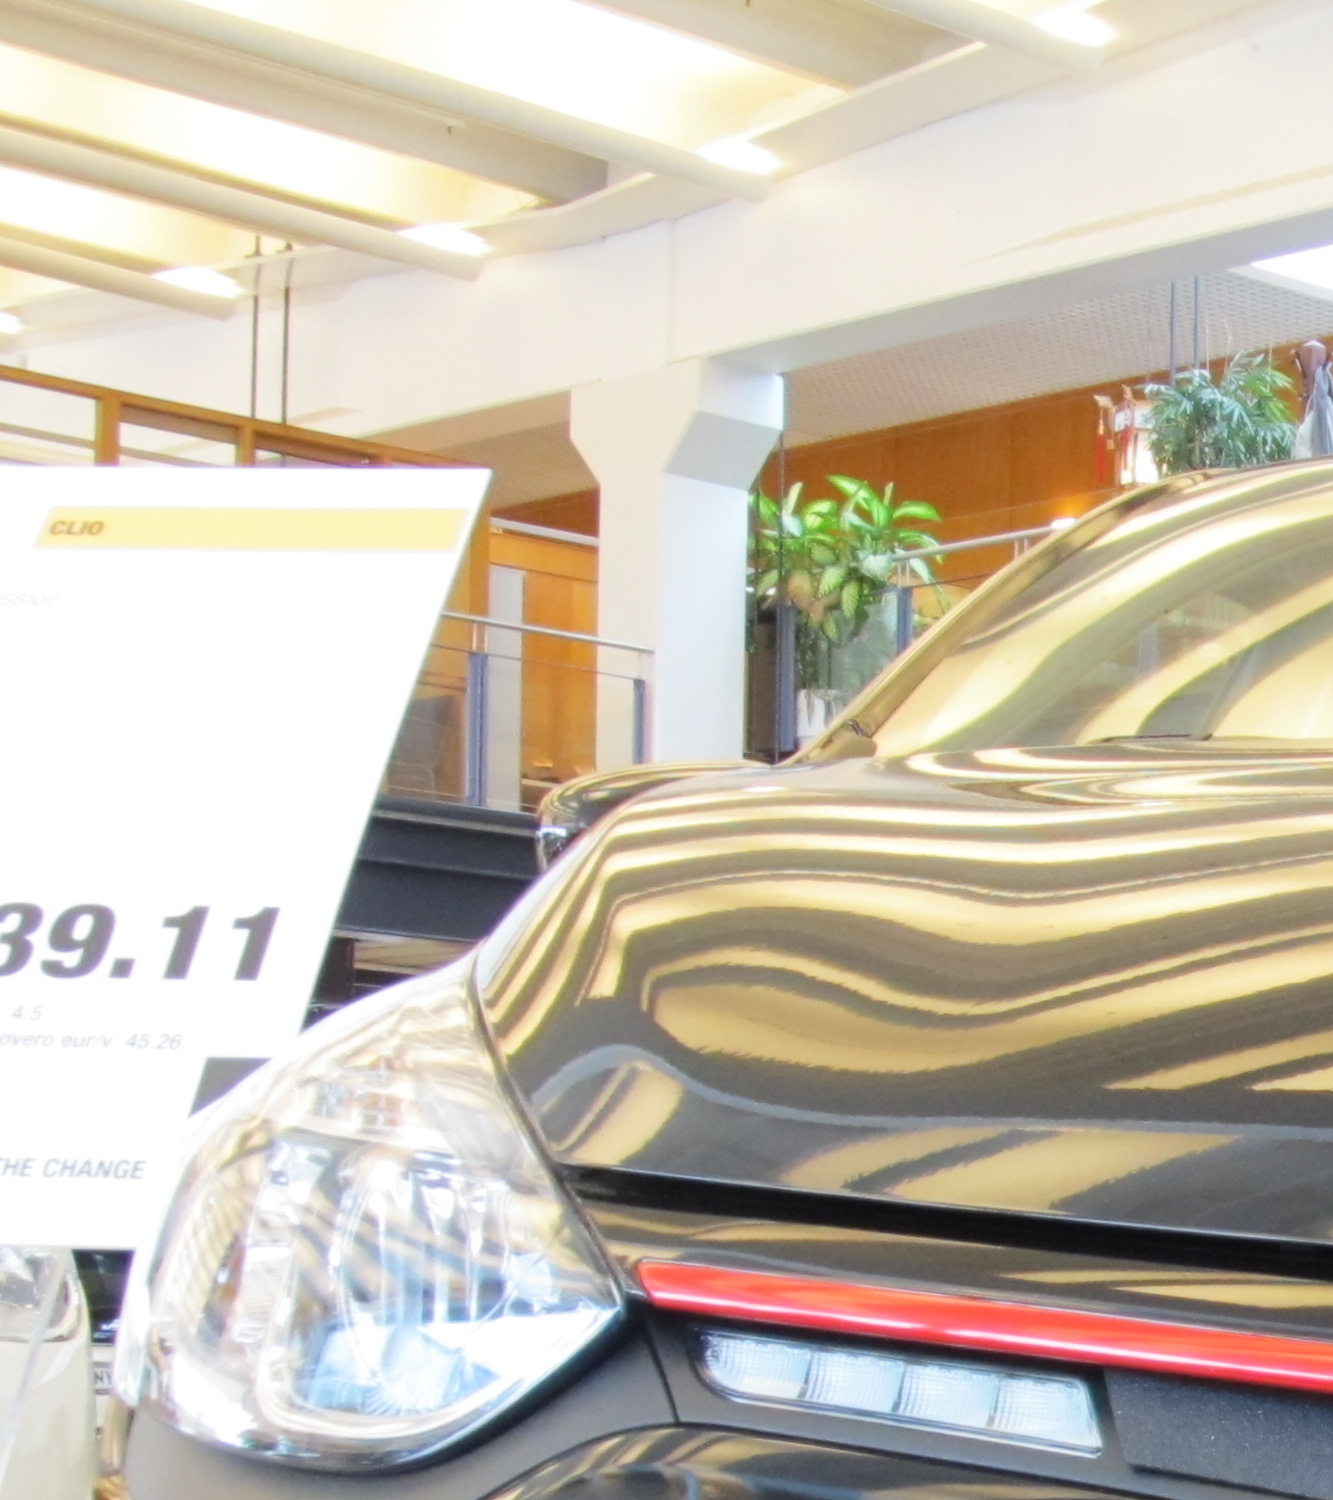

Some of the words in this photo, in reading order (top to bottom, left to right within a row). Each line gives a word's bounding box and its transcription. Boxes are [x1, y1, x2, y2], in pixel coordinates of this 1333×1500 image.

[48, 519, 106, 536] CLIO
[0, 901, 281, 981] 39.11
[11, 1005, 43, 1021] 4.5
[61, 1033, 114, 1049] eur/v
[125, 1033, 183, 1050] 45.26
[42, 1158, 147, 1180] CHANGE
